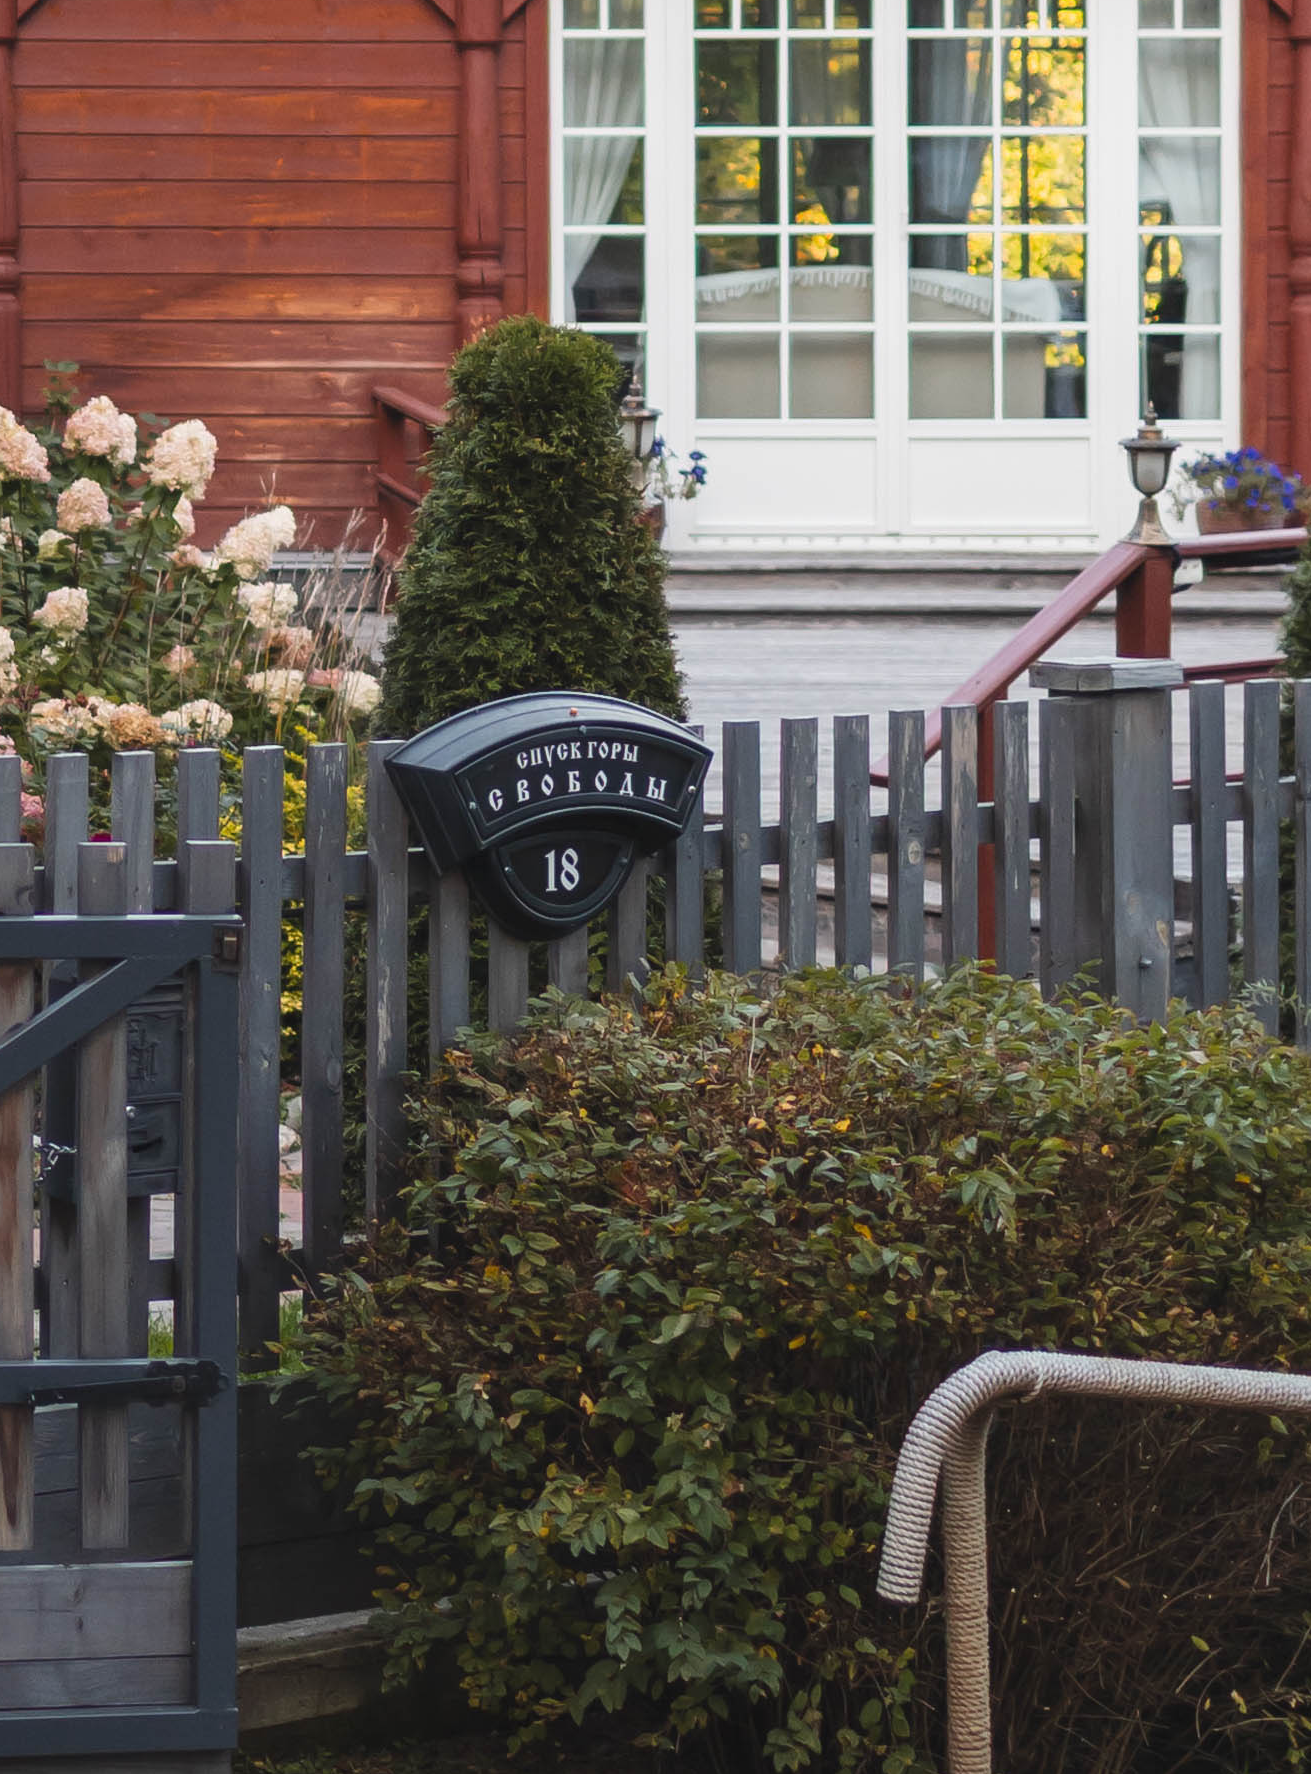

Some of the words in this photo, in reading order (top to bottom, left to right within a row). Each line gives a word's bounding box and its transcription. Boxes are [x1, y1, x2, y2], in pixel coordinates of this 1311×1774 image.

[516, 741, 582, 769] СПУСК
[587, 741, 640, 763] ГОРЫ
[488, 770, 667, 811] СВОБОДЫ
[544, 848, 579, 892] 18
